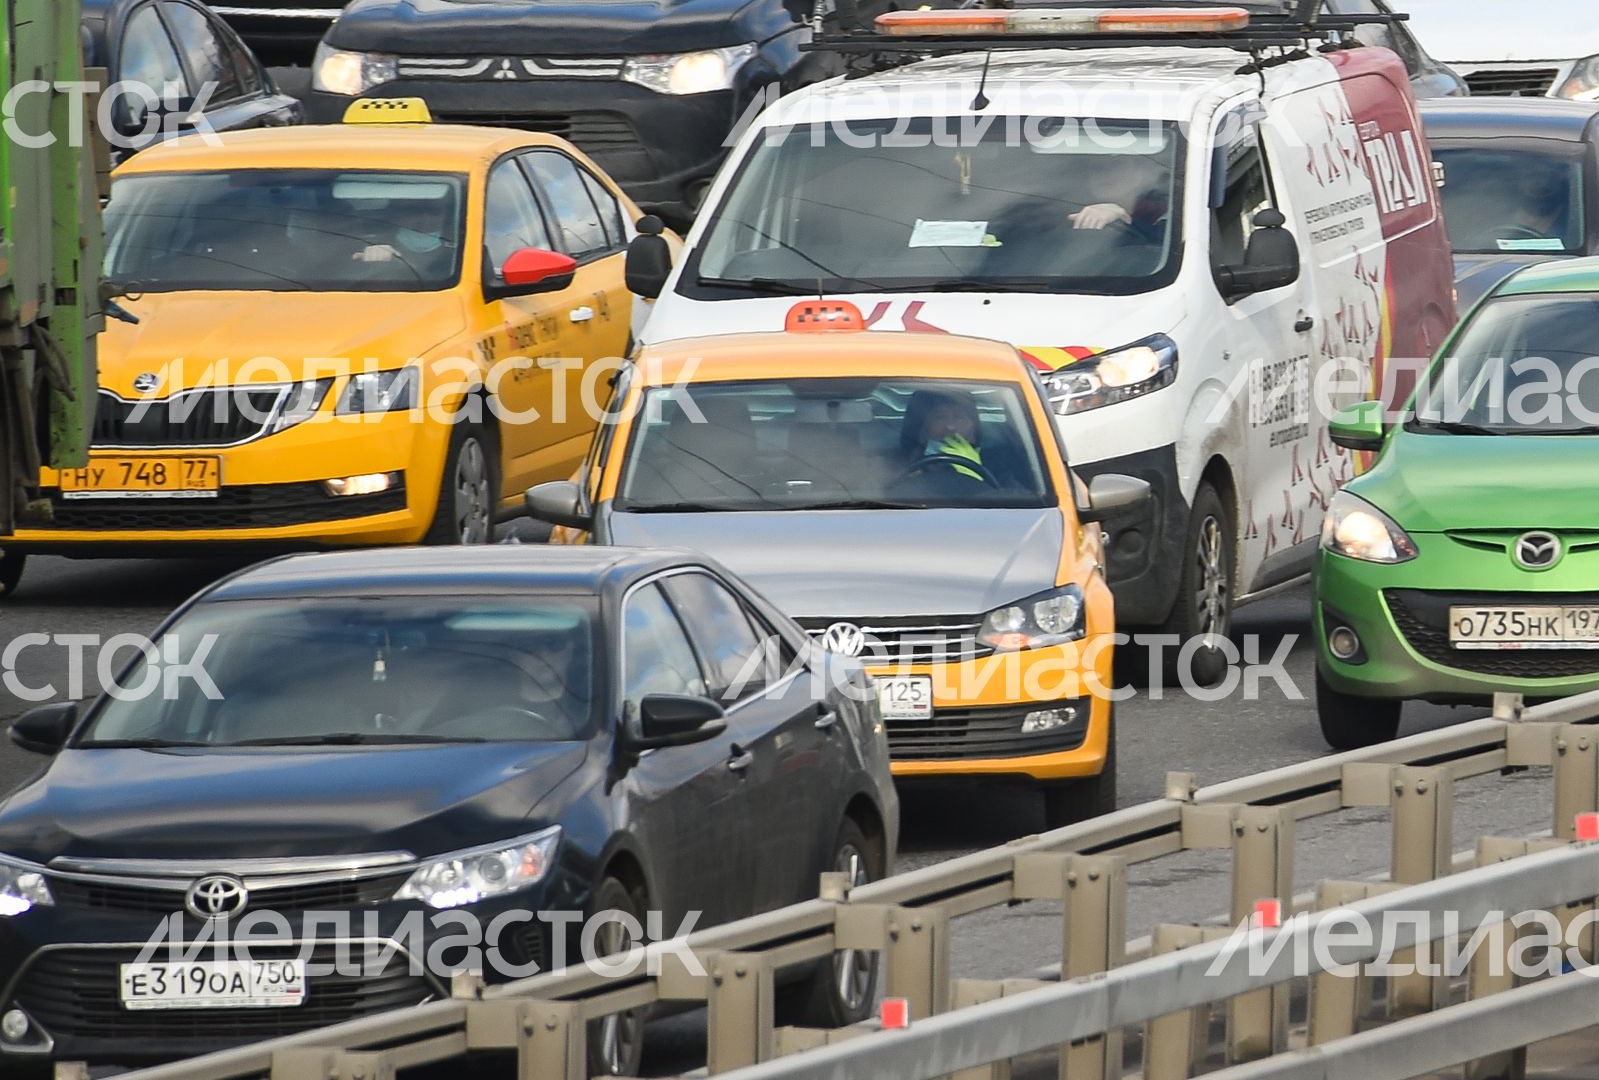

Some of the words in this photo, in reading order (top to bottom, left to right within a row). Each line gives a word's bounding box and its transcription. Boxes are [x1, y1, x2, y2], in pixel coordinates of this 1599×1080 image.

[119, 462, 167, 486] 748
[183, 460, 208, 479] 77
[884, 681, 923, 702] 125
[254, 961, 297, 985] 750
